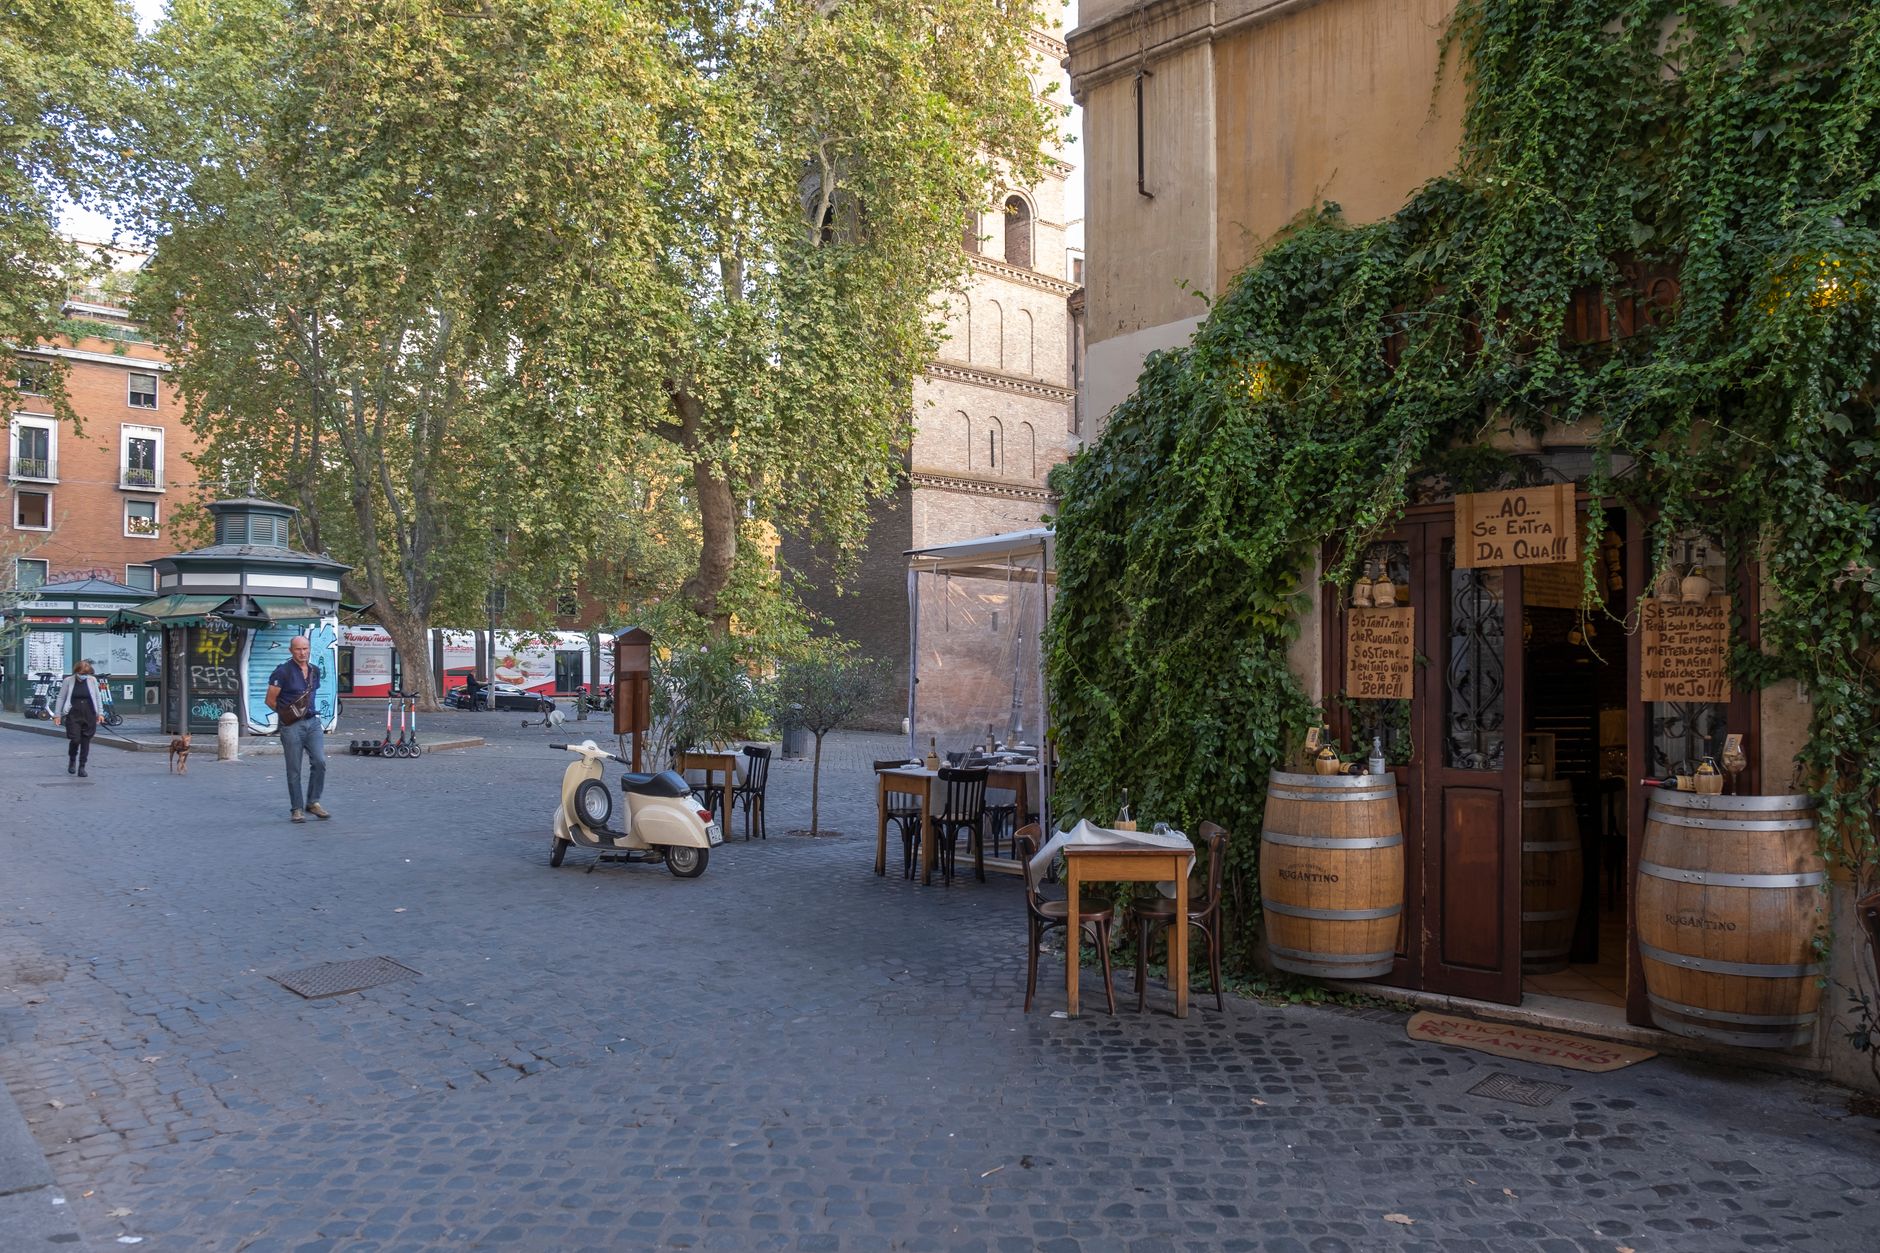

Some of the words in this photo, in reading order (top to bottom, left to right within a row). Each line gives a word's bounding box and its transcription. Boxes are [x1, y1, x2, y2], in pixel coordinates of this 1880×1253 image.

[1472, 521, 1497, 537] Se
[1645, 603, 1664, 619] Se
[1659, 633, 1676, 644] De
[190, 665, 239, 690] REPS
[1279, 868, 1339, 883] RUGANTINO
[1665, 914, 1737, 931] RUGANTINO
[1416, 1024, 1611, 1065] RUGANTINO
[1423, 1020, 1516, 1036] ANTICA
[1521, 1034, 1621, 1060] OSTERIA
